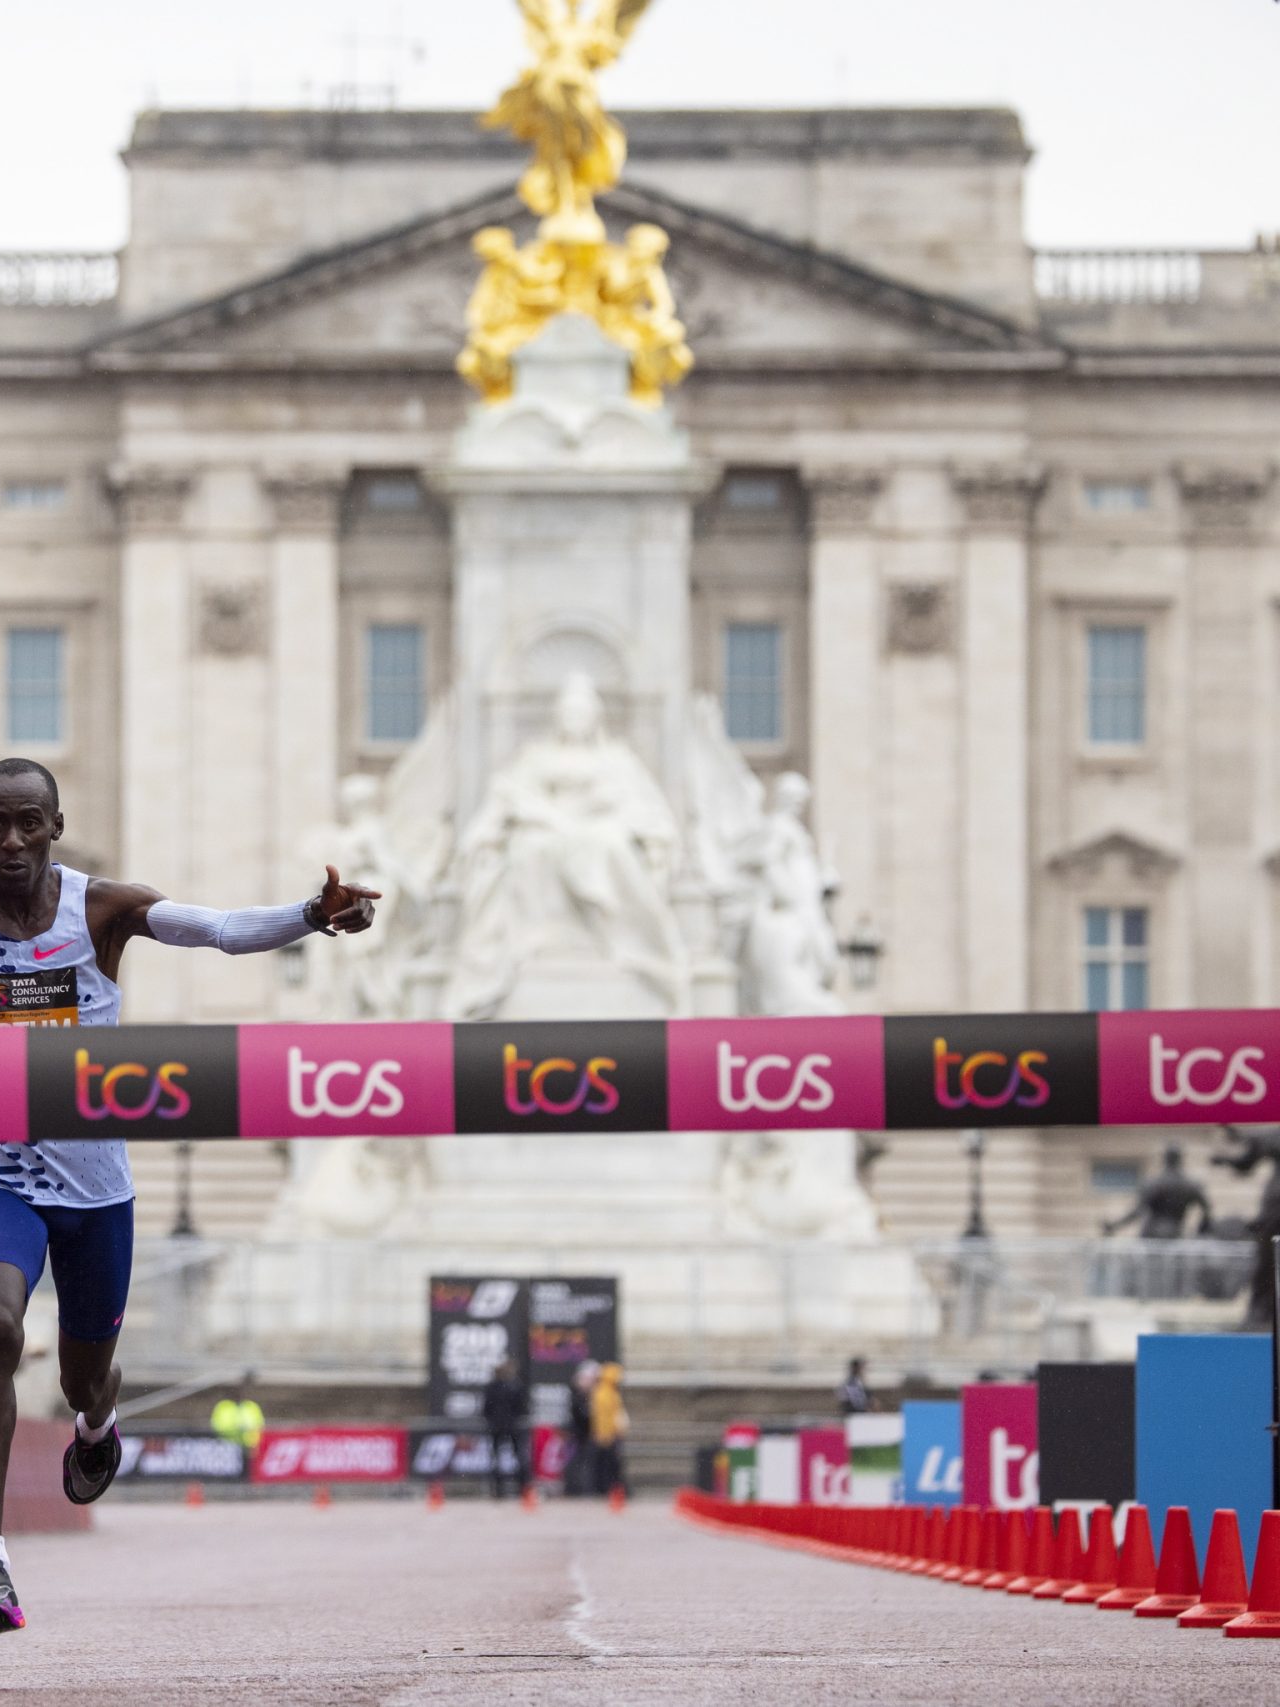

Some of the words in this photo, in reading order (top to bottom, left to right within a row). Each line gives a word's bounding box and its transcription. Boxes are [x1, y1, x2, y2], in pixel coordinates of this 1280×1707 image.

[10, 978, 36, 987] TATA
[11, 984, 70, 997] CONSULTANCY
[11, 995, 50, 1006] SERVICES
[74, 1048, 191, 1120] tcs
[286, 1045, 404, 1118] tcs
[502, 1043, 620, 1115] tcs
[715, 1039, 834, 1113] tcs
[932, 1036, 1050, 1108] tcs
[1149, 1033, 1267, 1106] tcs
